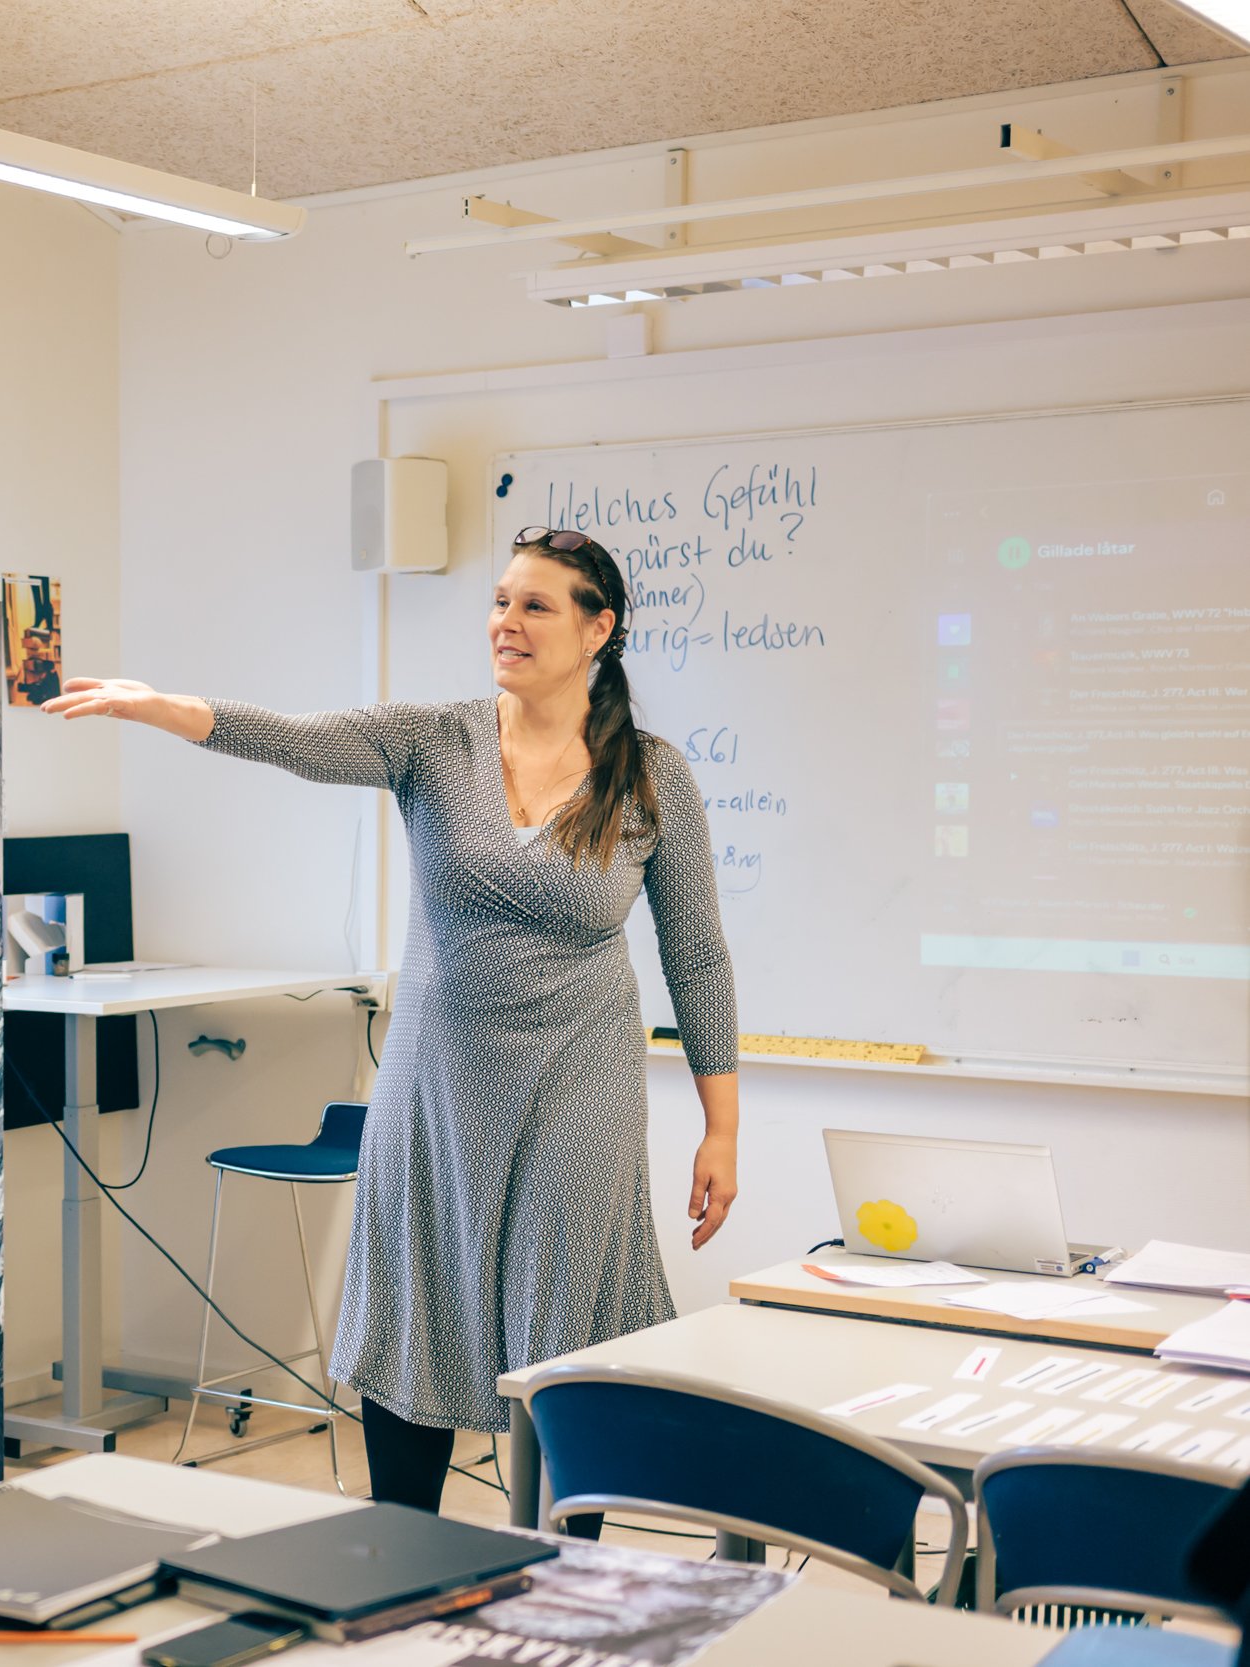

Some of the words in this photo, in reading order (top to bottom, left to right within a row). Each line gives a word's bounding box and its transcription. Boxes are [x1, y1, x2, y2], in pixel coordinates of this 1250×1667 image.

[703, 464, 817, 531] Gefühl
[1037, 543, 1094, 558] Gillade
[1096, 540, 1136, 555] låtar
